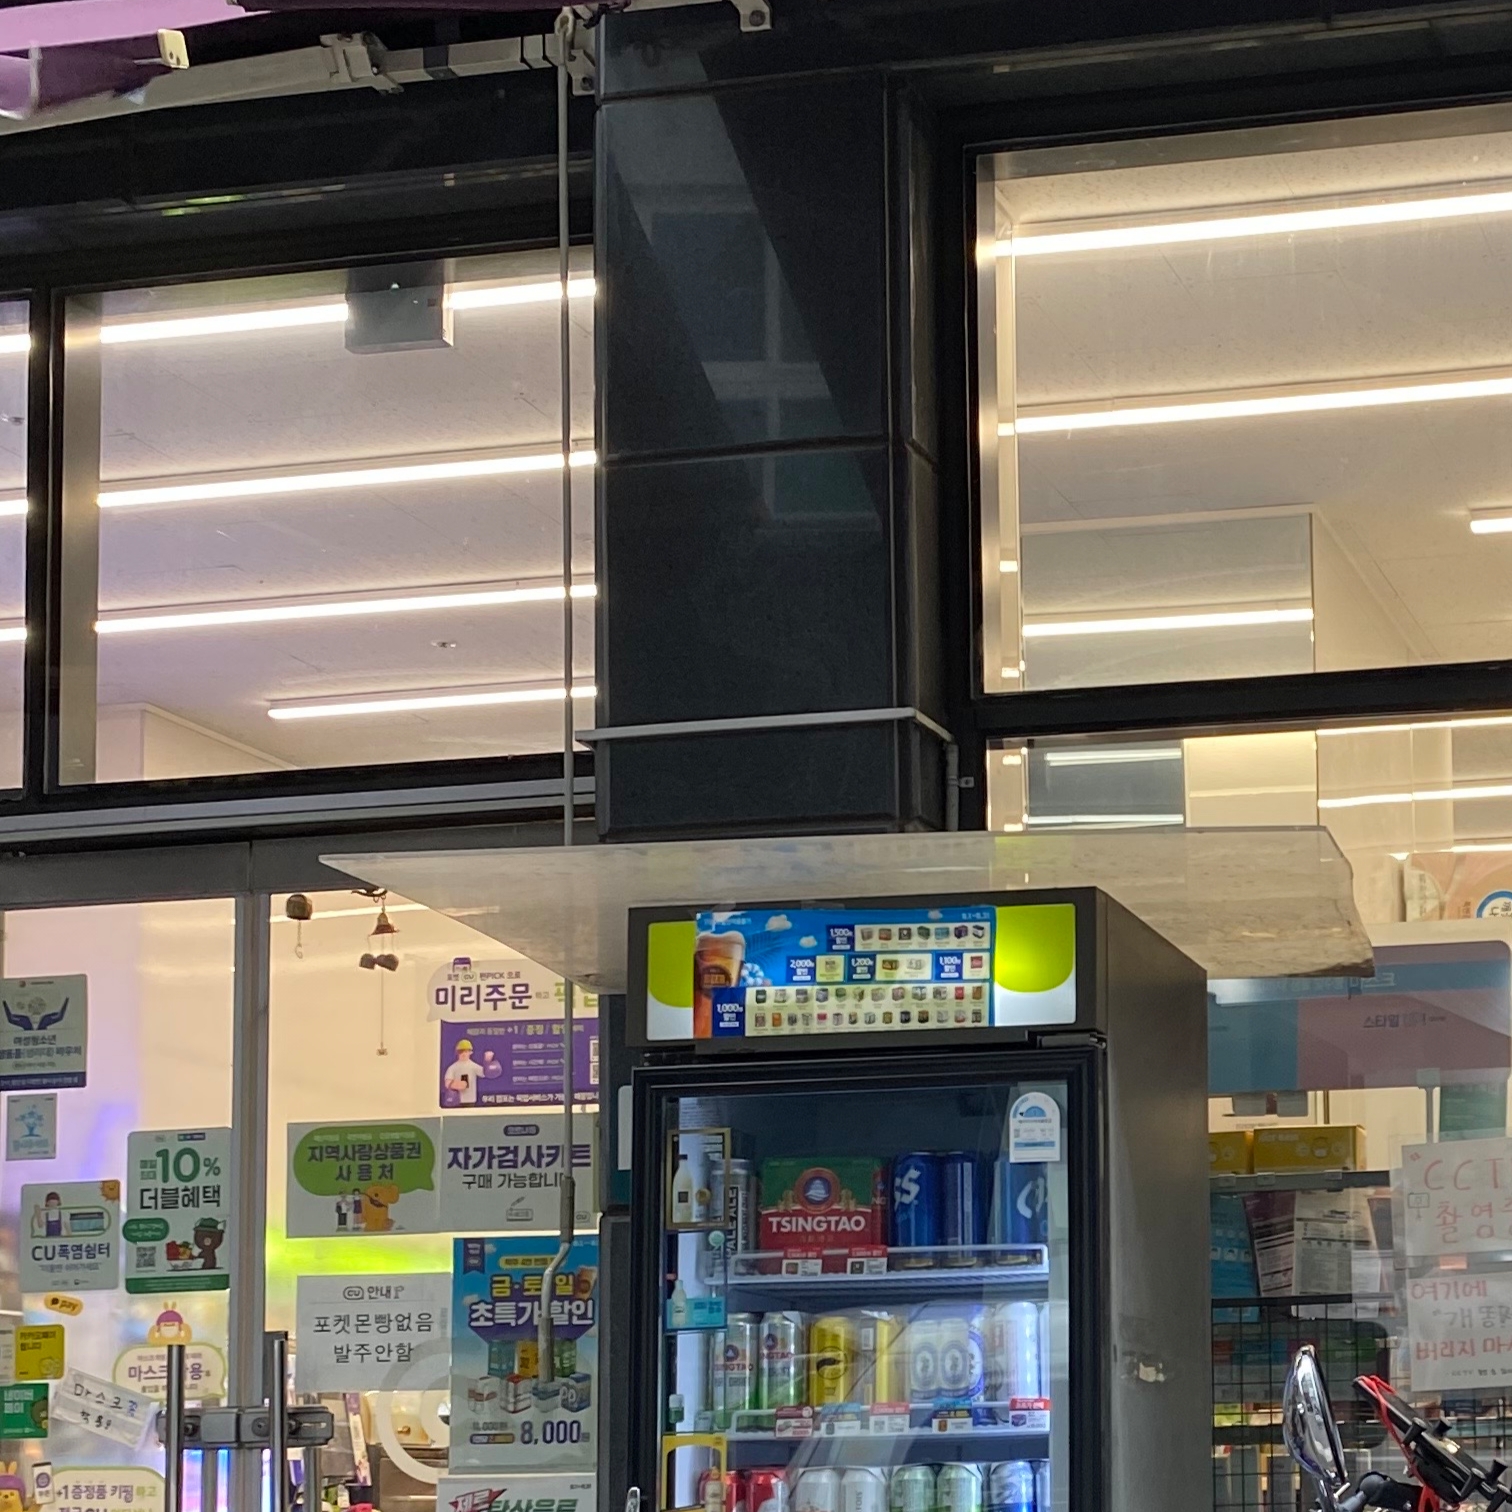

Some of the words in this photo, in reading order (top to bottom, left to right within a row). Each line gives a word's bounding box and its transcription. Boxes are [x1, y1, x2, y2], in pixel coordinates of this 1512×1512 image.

[435, 983, 532, 1012] 미리주문
[307, 1142, 422, 1163] 지역사랑상품권
[447, 1144, 592, 1170] 자가검사키트
[155, 1147, 221, 1184] 10%
[462, 1173, 493, 1190] 구매
[497, 1172, 563, 1189] 가능합니
[140, 1184, 221, 1210] 더블혜택
[768, 1215, 866, 1233] TSINGTAO
[1411, 1279, 1488, 1301] 여기에
[313, 1312, 435, 1335] 포켓몬빵없음
[333, 1342, 415, 1364] 발주안함
[1415, 1338, 1476, 1361] 버리지
[71, 1484, 108, 1500] 증정품
[110, 1484, 134, 1503] 키핑
[136, 1485, 157, 1498] 하고
